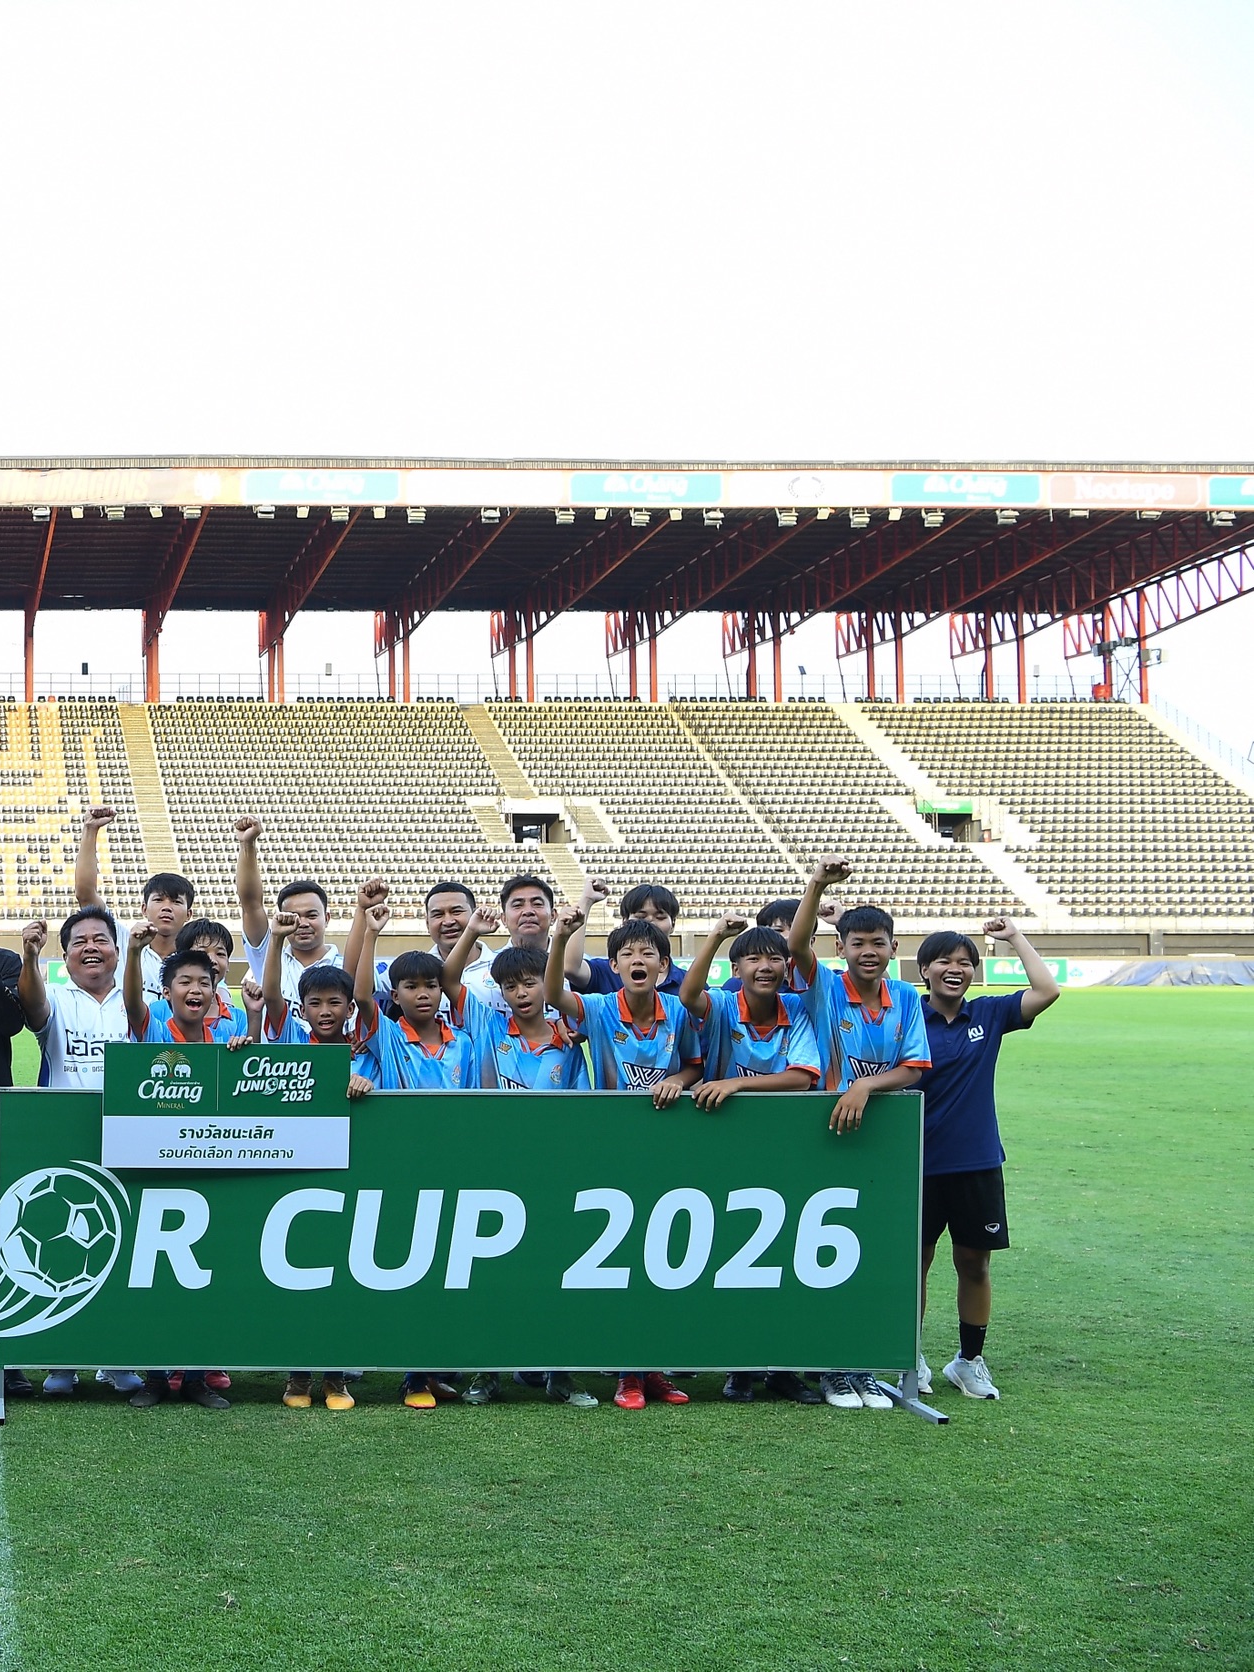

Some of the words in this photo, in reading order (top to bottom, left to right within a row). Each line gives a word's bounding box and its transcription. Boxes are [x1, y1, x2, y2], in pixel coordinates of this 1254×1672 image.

[1074, 476, 1175, 504] Neotape
[968, 1025, 984, 1039] KU
[242, 1056, 312, 1080] Chang
[138, 1079, 203, 1103] Chang
[232, 1078, 287, 1096] JUNIOR
[288, 1078, 315, 1090] CUP
[281, 1090, 313, 1102] 2026
[178, 1124, 274, 1139] รางวัลชนะเลิศ
[159, 1146, 233, 1159] รอบคัดเลือก
[237, 1149, 294, 1159] ภาคกลาง
[260, 1188, 527, 1291] CUP
[561, 1187, 861, 1290] 2026
